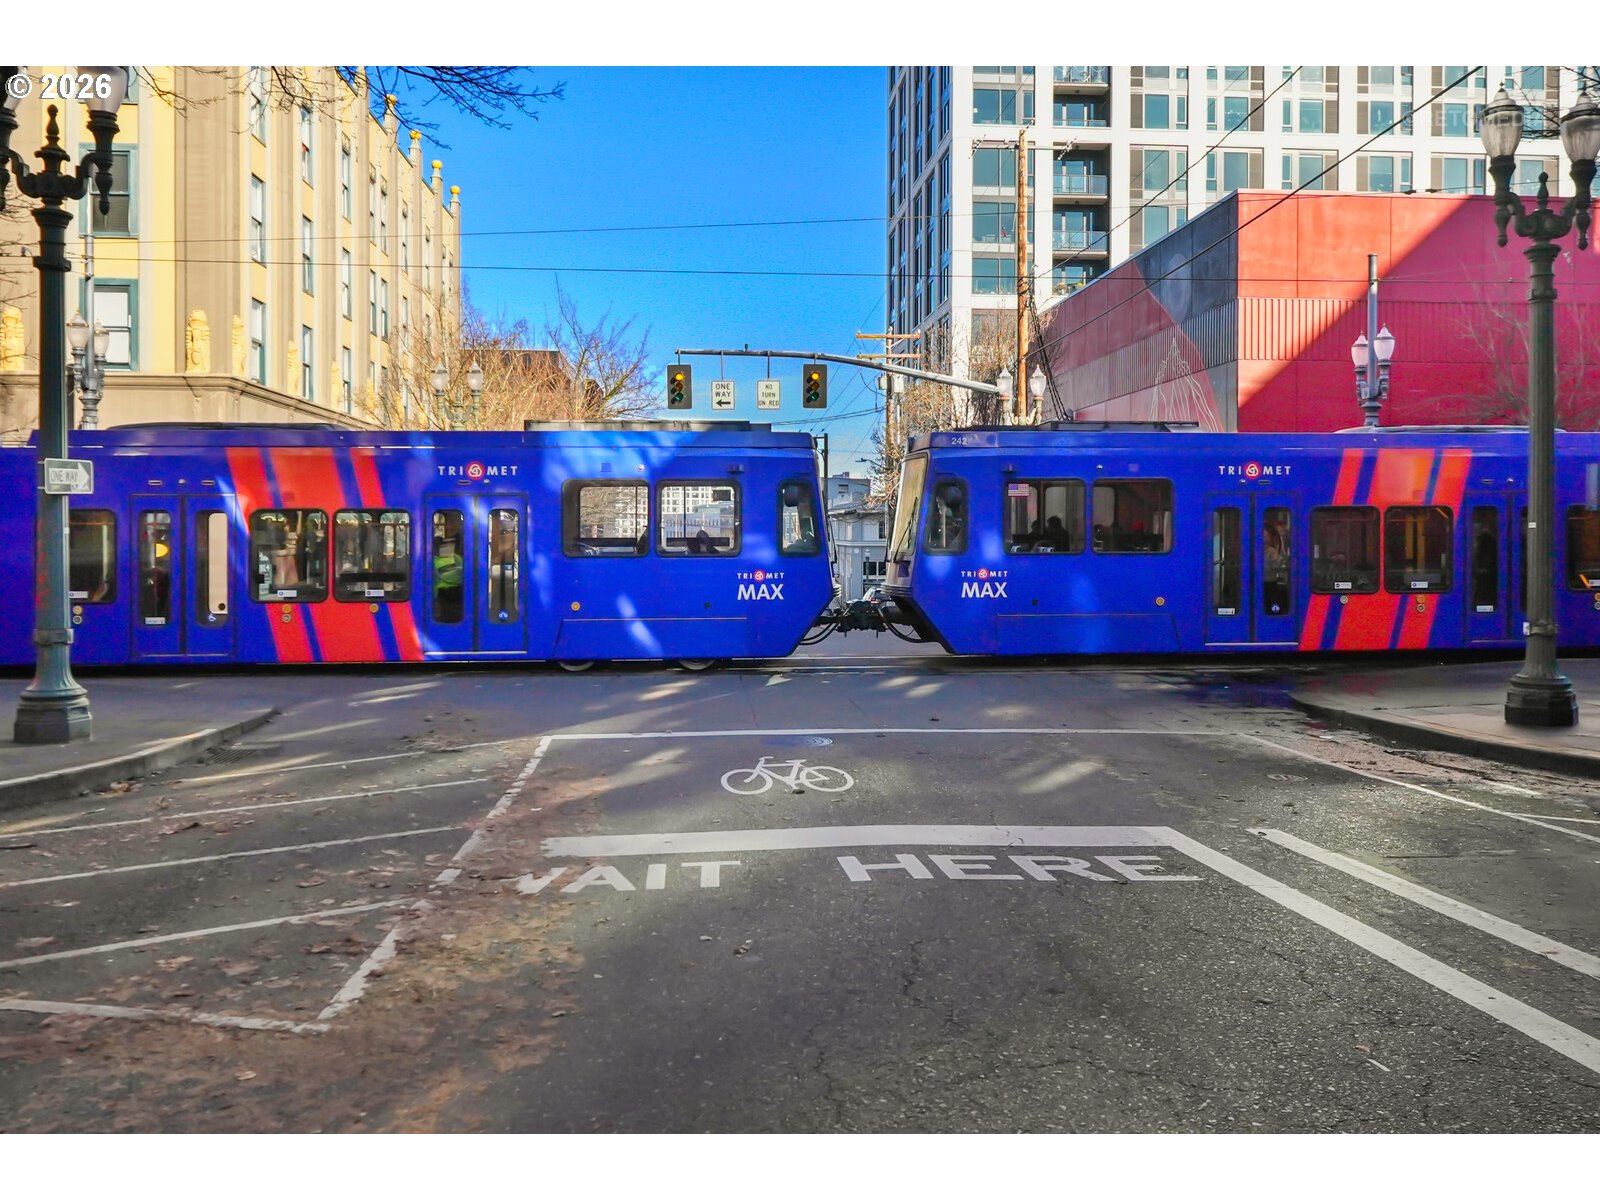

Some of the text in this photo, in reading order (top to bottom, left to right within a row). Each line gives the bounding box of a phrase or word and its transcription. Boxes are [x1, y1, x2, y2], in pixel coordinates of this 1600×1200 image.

[951, 437, 968, 446] 242
[51, 470, 77, 482] ONE WAY
[737, 583, 785, 601] MAX
[961, 581, 1008, 599] MAX
[835, 853, 1205, 882] HERE
